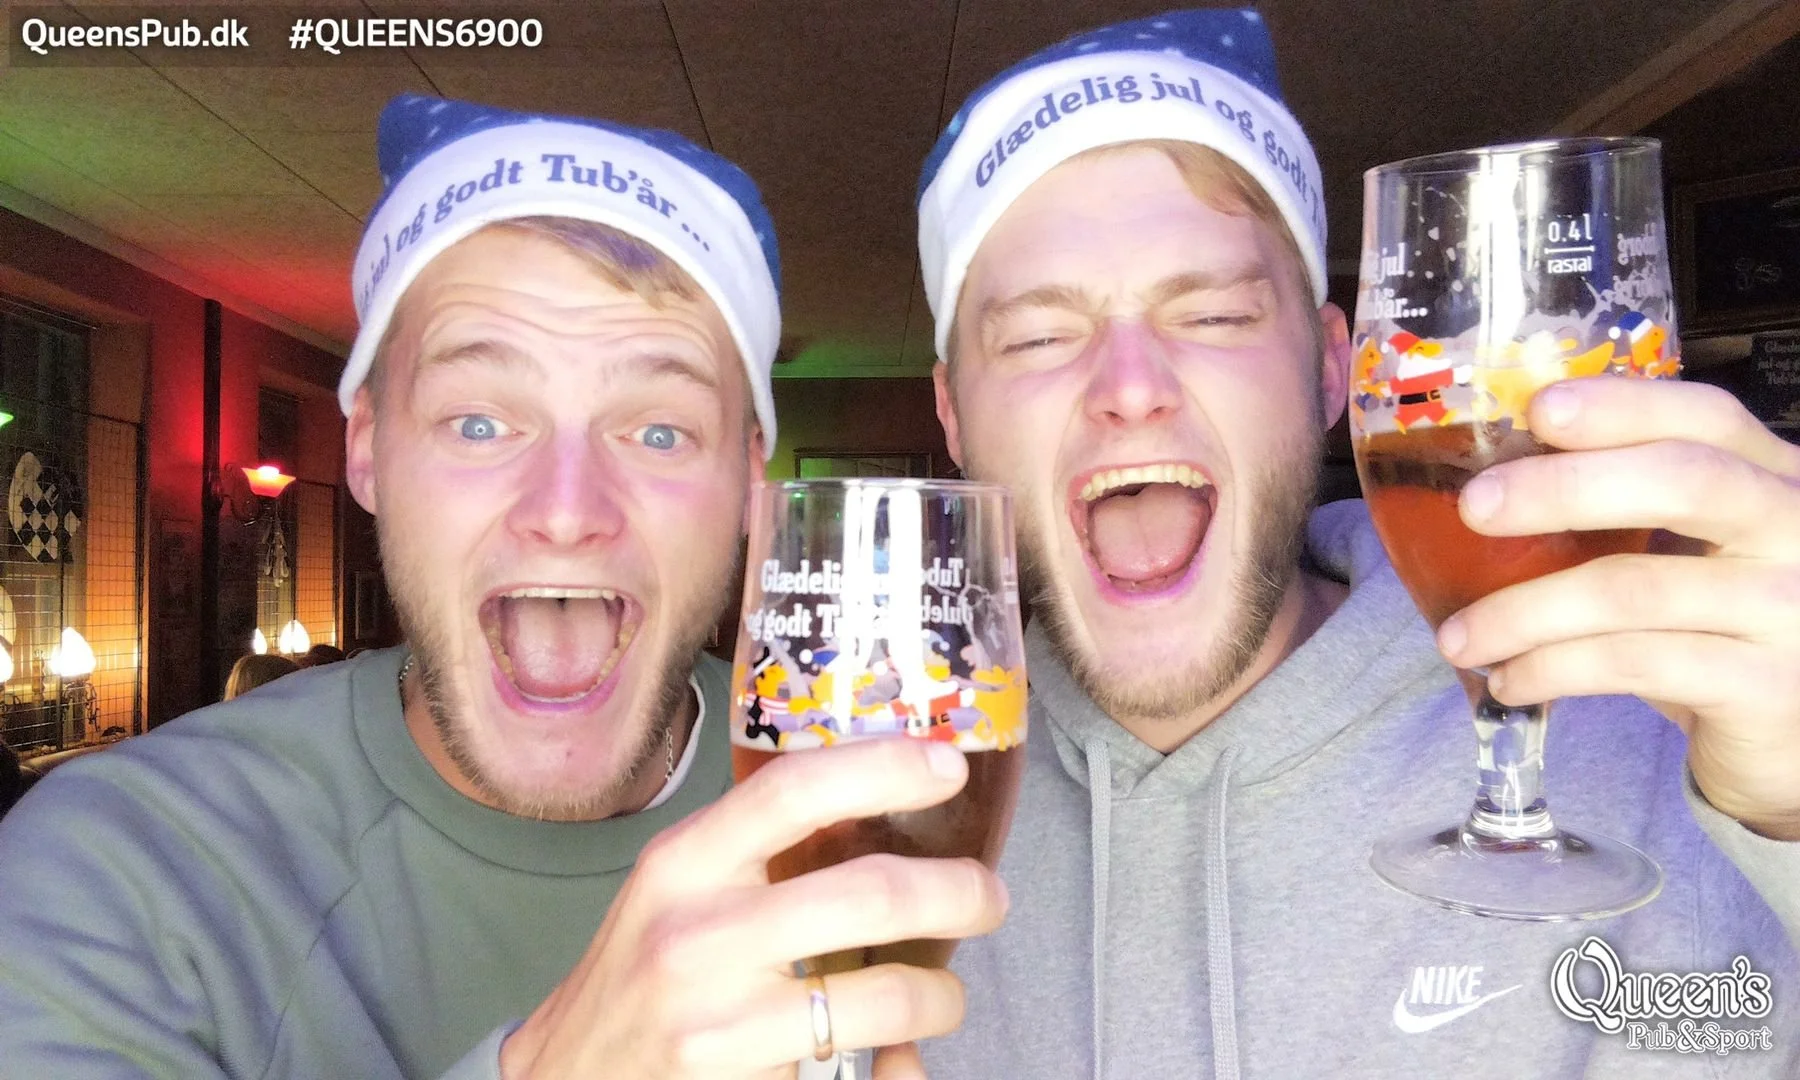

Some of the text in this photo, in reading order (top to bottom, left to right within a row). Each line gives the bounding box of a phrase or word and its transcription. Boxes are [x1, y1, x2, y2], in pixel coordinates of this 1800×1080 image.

[975, 72, 1308, 204] Glædelig jul og godt
[396, 203, 426, 252] og
[434, 158, 524, 224] godt
[1376, 242, 1405, 285] jul
[761, 559, 843, 594] Glædeli
[763, 603, 812, 642] godt
[1411, 965, 1484, 1005] NIKE
